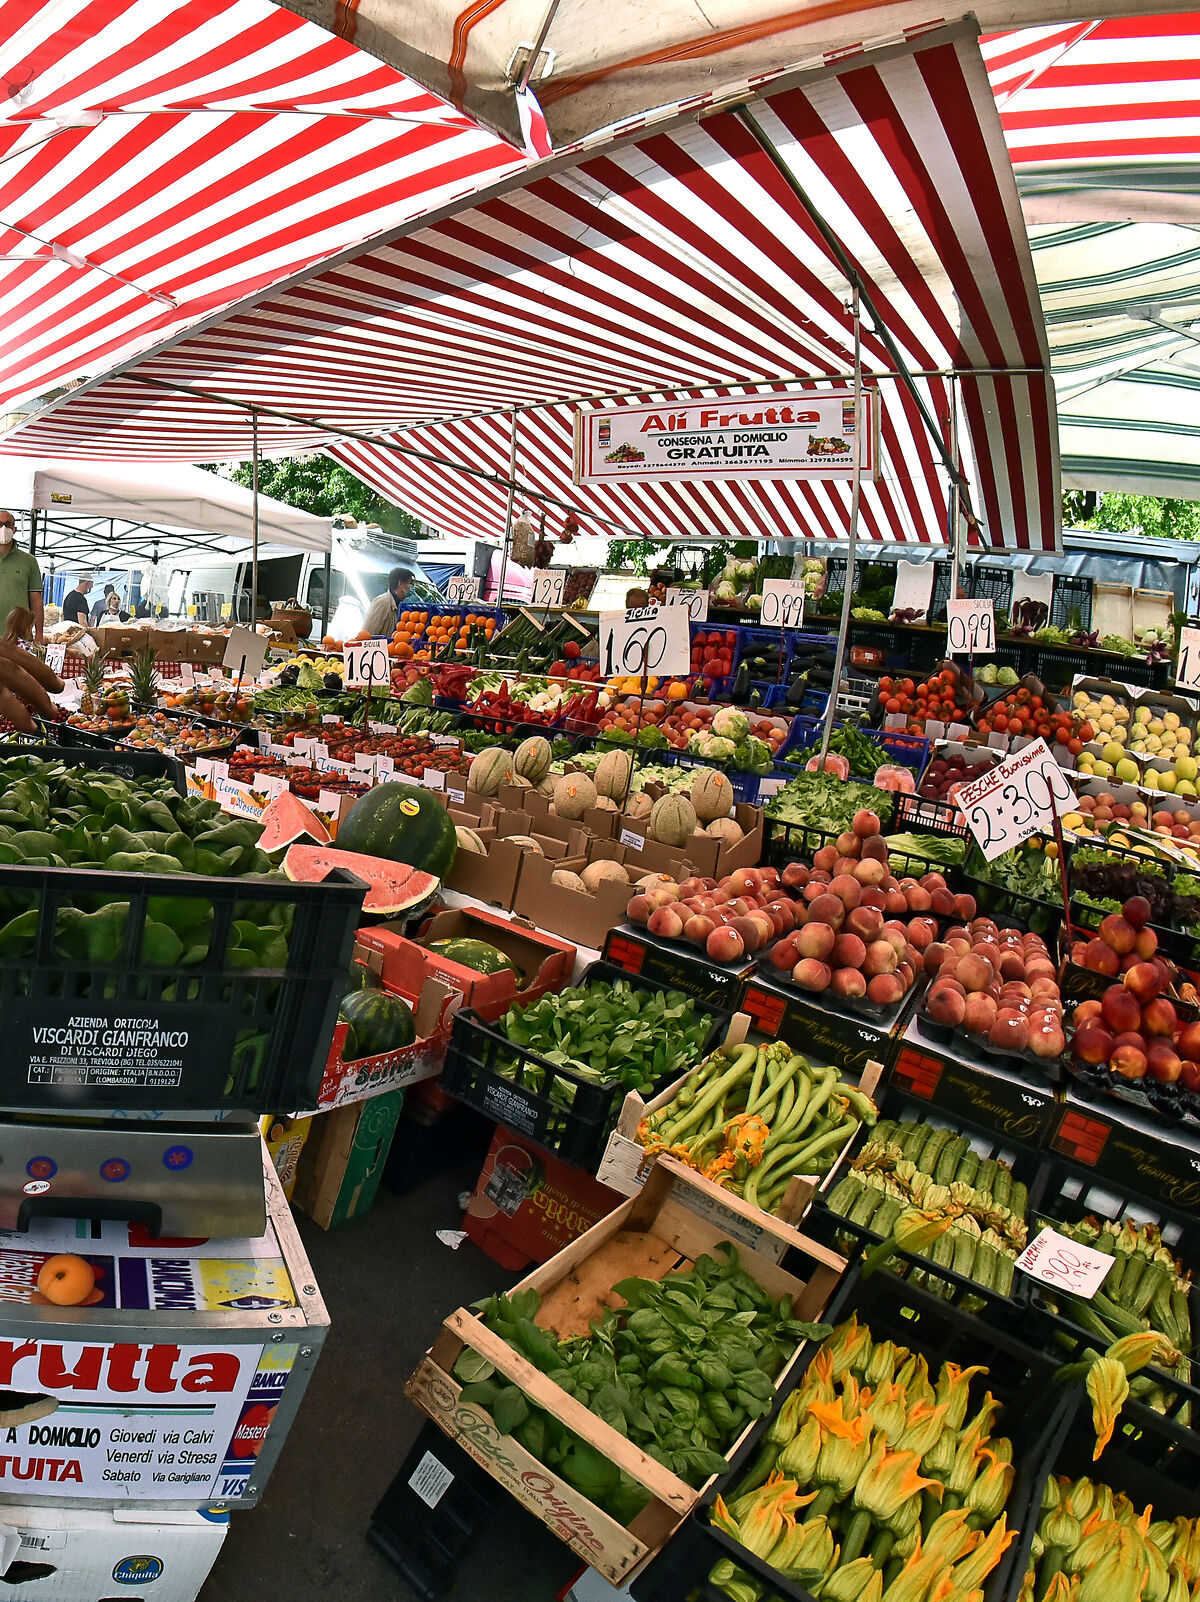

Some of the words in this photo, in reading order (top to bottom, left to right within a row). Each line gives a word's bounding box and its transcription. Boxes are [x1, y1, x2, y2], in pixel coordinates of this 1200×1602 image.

[701, 405, 820, 428] Frutta
[658, 435, 712, 447] CONSEGNA
[717, 434, 725, 444] A
[667, 445, 770, 460] GRATUITA
[216, 777, 240, 796] Terra
[960, 770, 999, 804] PESCHE
[233, 797, 263, 816] Nostra
[68, 1017, 108, 1028] AZIENDA
[114, 1018, 159, 1029] ORTICOLA
[33, 1027, 98, 1045] VISCARDI
[102, 1030, 189, 1047] GIANFRANCO
[61, 1047, 72, 1056] DI
[76, 1047, 123, 1057] VISCARDI
[126, 1048, 158, 1058] DIEGO
[90, 1058, 119, 1066] TREVIOLO
[90, 1068, 121, 1076] ORIGINE:
[508, 1097, 538, 1119] GIANFRANCO
[6, 1427, 17, 1443] A
[163, 1431, 180, 1444] via
[183, 1430, 214, 1444] Calvi
[157, 1452, 175, 1464] via
[177, 1450, 217, 1464] Stresa
[102, 1469, 141, 1482] Sabato
[152, 1472, 166, 1482] Via
[168, 1472, 211, 1485] Garigliano
[221, 1479, 248, 1496] VIS
[520, 1471, 605, 1551] Origine
[114, 1571, 160, 1582] Chiquita
